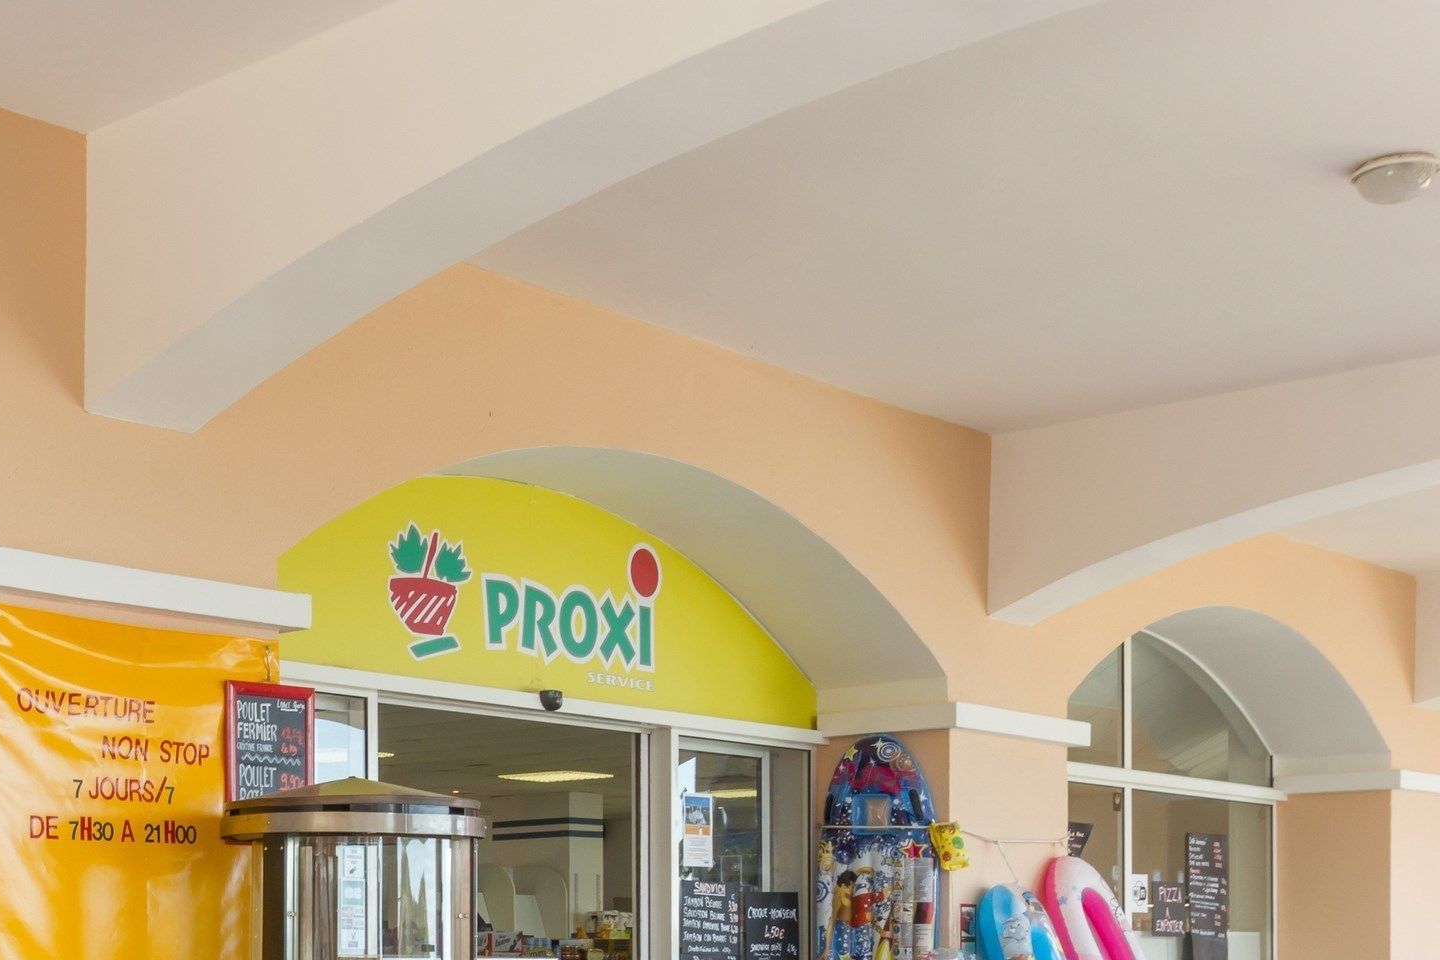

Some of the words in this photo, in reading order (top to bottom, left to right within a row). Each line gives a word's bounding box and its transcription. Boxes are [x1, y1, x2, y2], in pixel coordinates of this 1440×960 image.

[483, 545, 660, 670] PROXI
[587, 671, 656, 692] SERVICE
[17, 688, 155, 724] OUVERTURE
[237, 700, 271, 722] POULET
[102, 736, 149, 761] NON
[160, 740, 210, 765] STOP
[257, 743, 273, 753] FRANCE
[239, 763, 276, 787] POULET
[73, 780, 83, 798] 7
[89, 776, 175, 804] JOURS/7
[30, 815, 59, 839] DE
[68, 817, 114, 841] 7H30
[121, 820, 135, 842] A
[145, 821, 197, 844] 21H00
[1159, 885, 1182, 903] PIZZA
